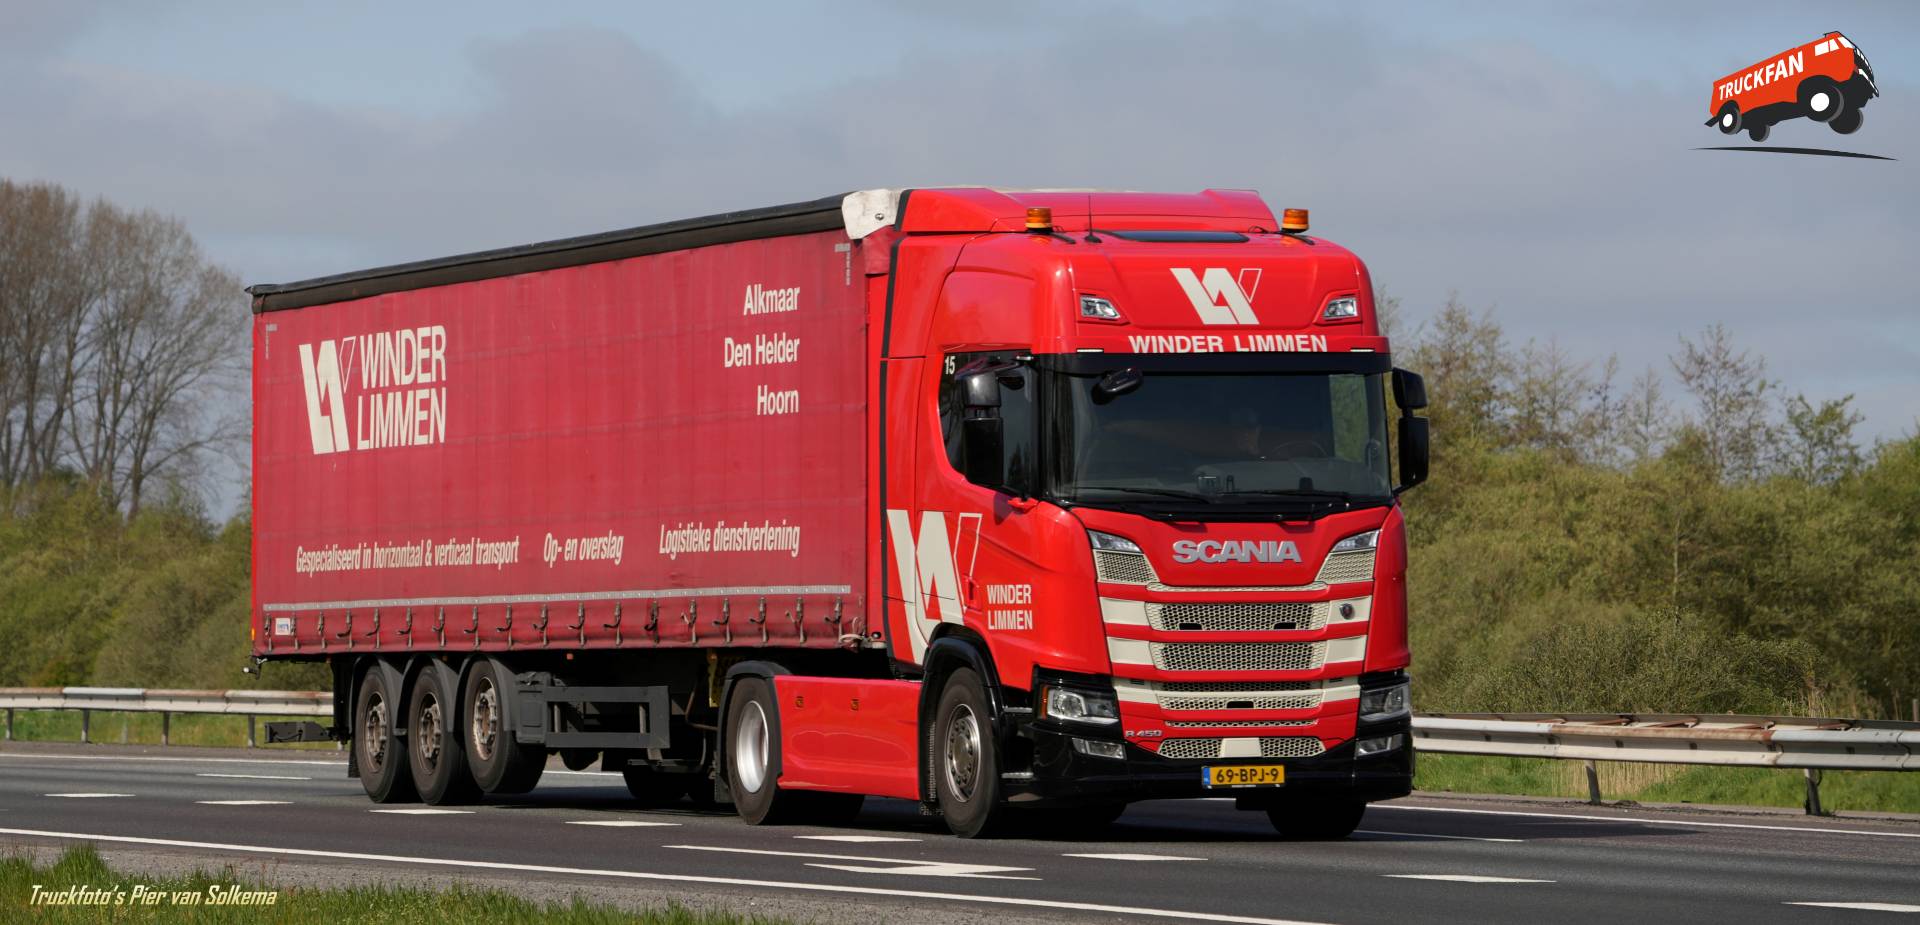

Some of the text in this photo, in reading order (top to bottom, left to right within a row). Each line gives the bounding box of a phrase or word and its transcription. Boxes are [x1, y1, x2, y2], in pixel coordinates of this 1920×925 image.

[743, 283, 800, 316] Alkmaar
[360, 325, 446, 389] WINDER
[724, 331, 800, 368] Den Helder
[1128, 335, 1328, 353] WINDER LIMMEN
[945, 355, 956, 375] 15
[757, 384, 799, 416] Hoorn
[357, 387, 446, 450] LIMMEN
[543, 530, 624, 568] Op- en overslag
[659, 519, 800, 560] Logistieke dienstverlening
[1172, 540, 1302, 563] SCANIA
[296, 535, 519, 578] Gespecialiseerd in horizontaal & verticaal transport
[987, 584, 1031, 604] WINDER
[987, 610, 1033, 630] LIMMEN
[1125, 729, 1162, 738] R 450
[1216, 768, 1279, 783] 69-BPJ-9
